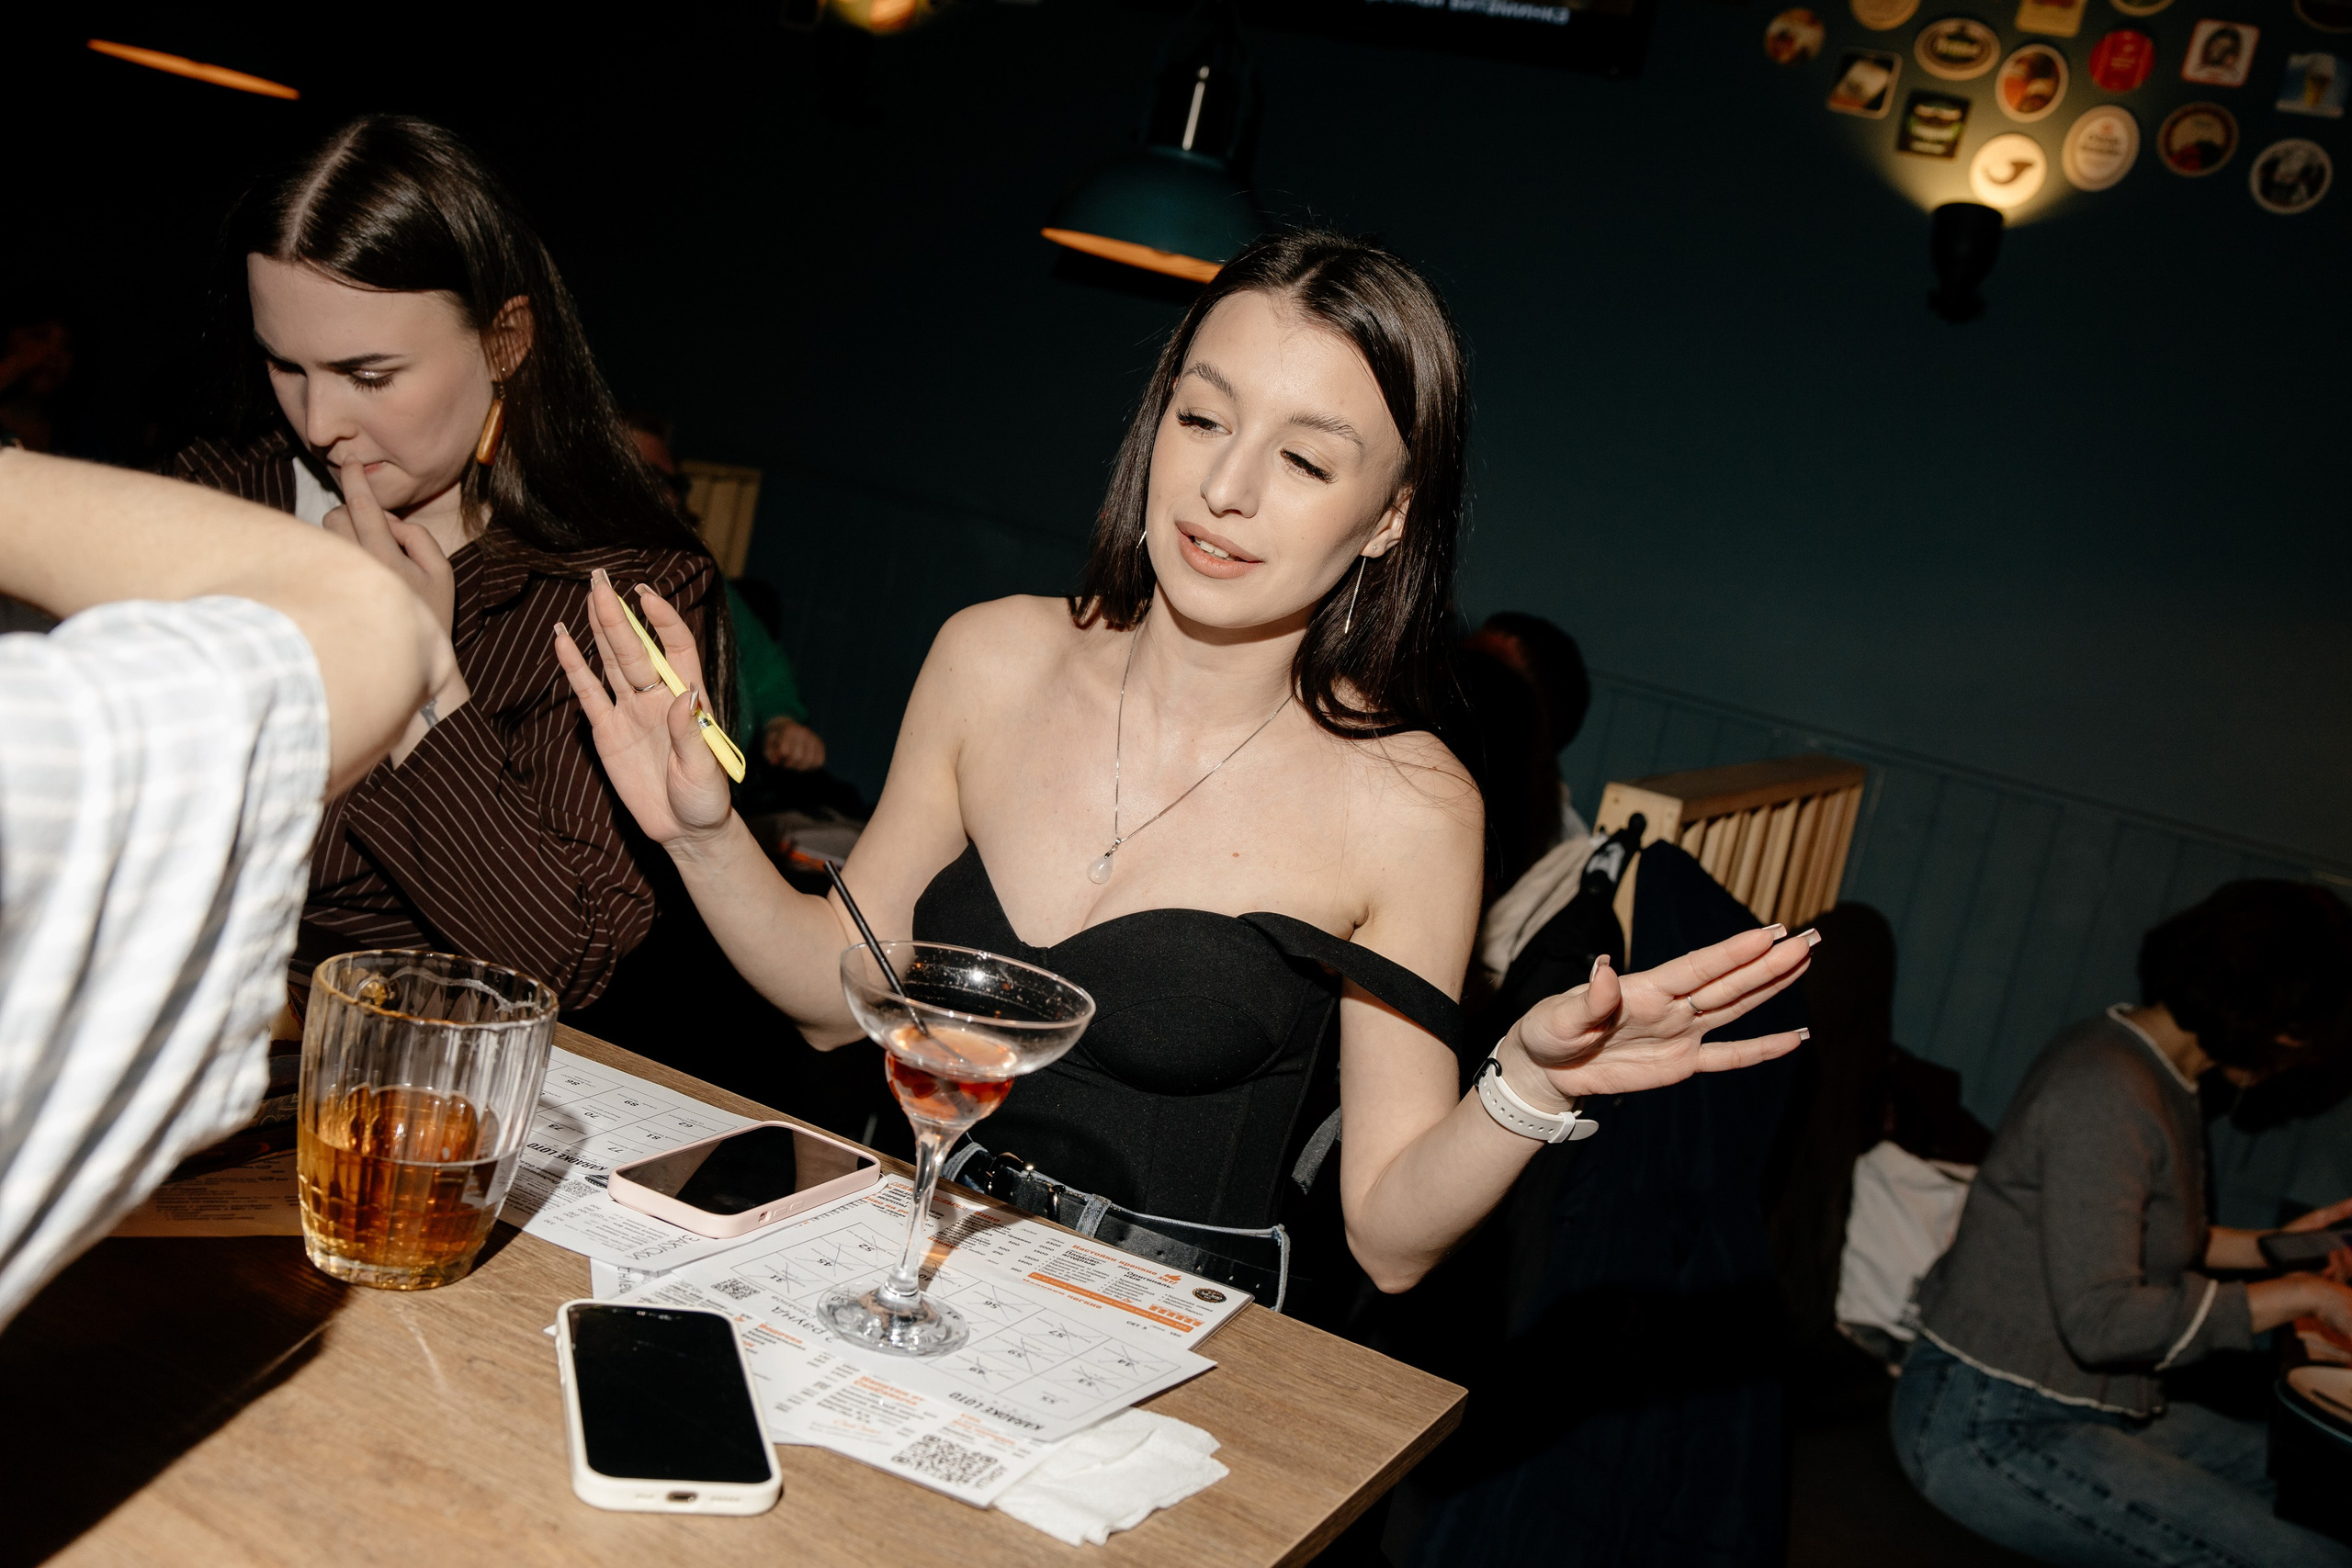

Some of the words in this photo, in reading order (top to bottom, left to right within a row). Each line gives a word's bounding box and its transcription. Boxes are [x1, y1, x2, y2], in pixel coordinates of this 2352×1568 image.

[526, 1143, 558, 1156] LOTO
[553, 1153, 608, 1171] KARAOKE
[973, 1211, 1001, 1223] Вино
[625, 1235, 700, 1260] ЗАКУСКИ
[858, 1244, 875, 1252] 52
[1072, 1245, 1117, 1262] Настойки
[1118, 1260, 1158, 1276] крепкие
[1126, 1271, 1171, 1289] Оригиналь-
[983, 1301, 1001, 1309] 56
[771, 1306, 830, 1335] раунд
[1048, 1330, 1067, 1338] 57
[948, 1393, 984, 1409] LOTO
[983, 1407, 1044, 1430] KARAOKE
